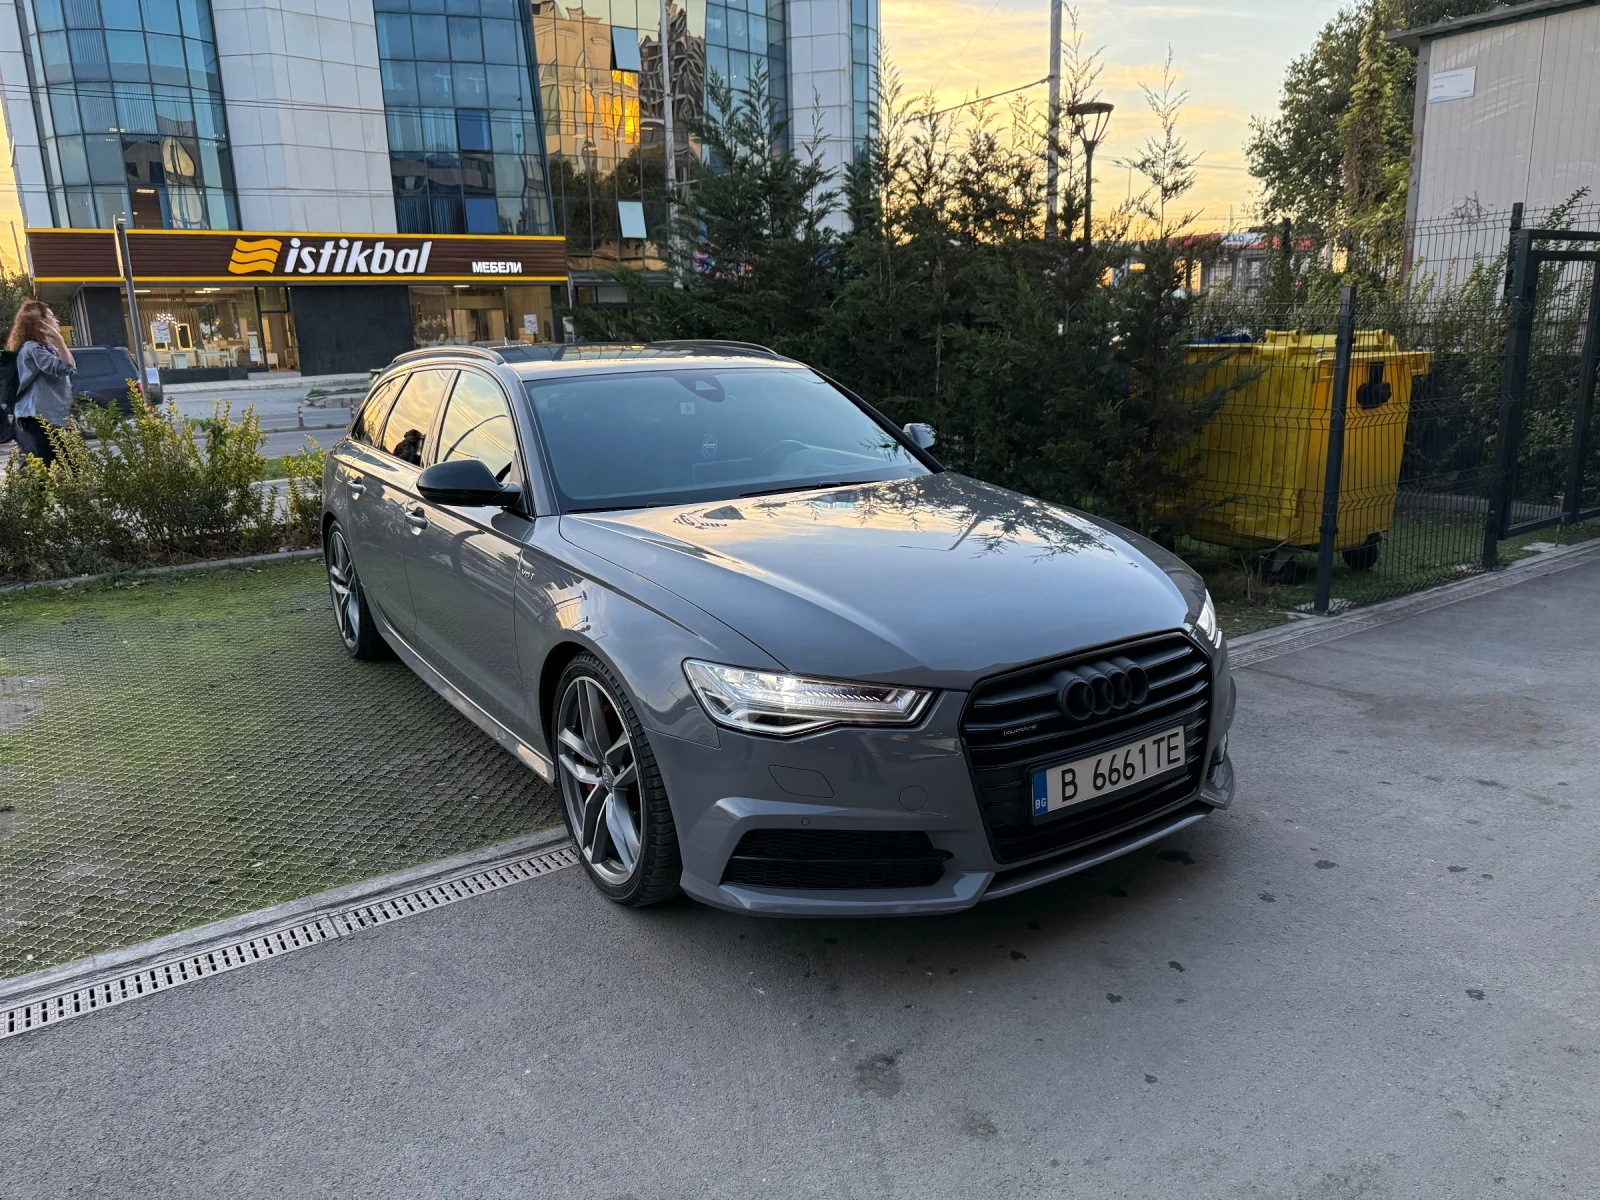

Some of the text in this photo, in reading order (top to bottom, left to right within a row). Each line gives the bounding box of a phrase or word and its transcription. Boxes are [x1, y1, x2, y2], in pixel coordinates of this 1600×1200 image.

[284, 238, 433, 274] istikbal
[471, 261, 523, 274] МЕБЕЛИ
[1061, 767, 1078, 803] B
[1035, 797, 1047, 810] BG
